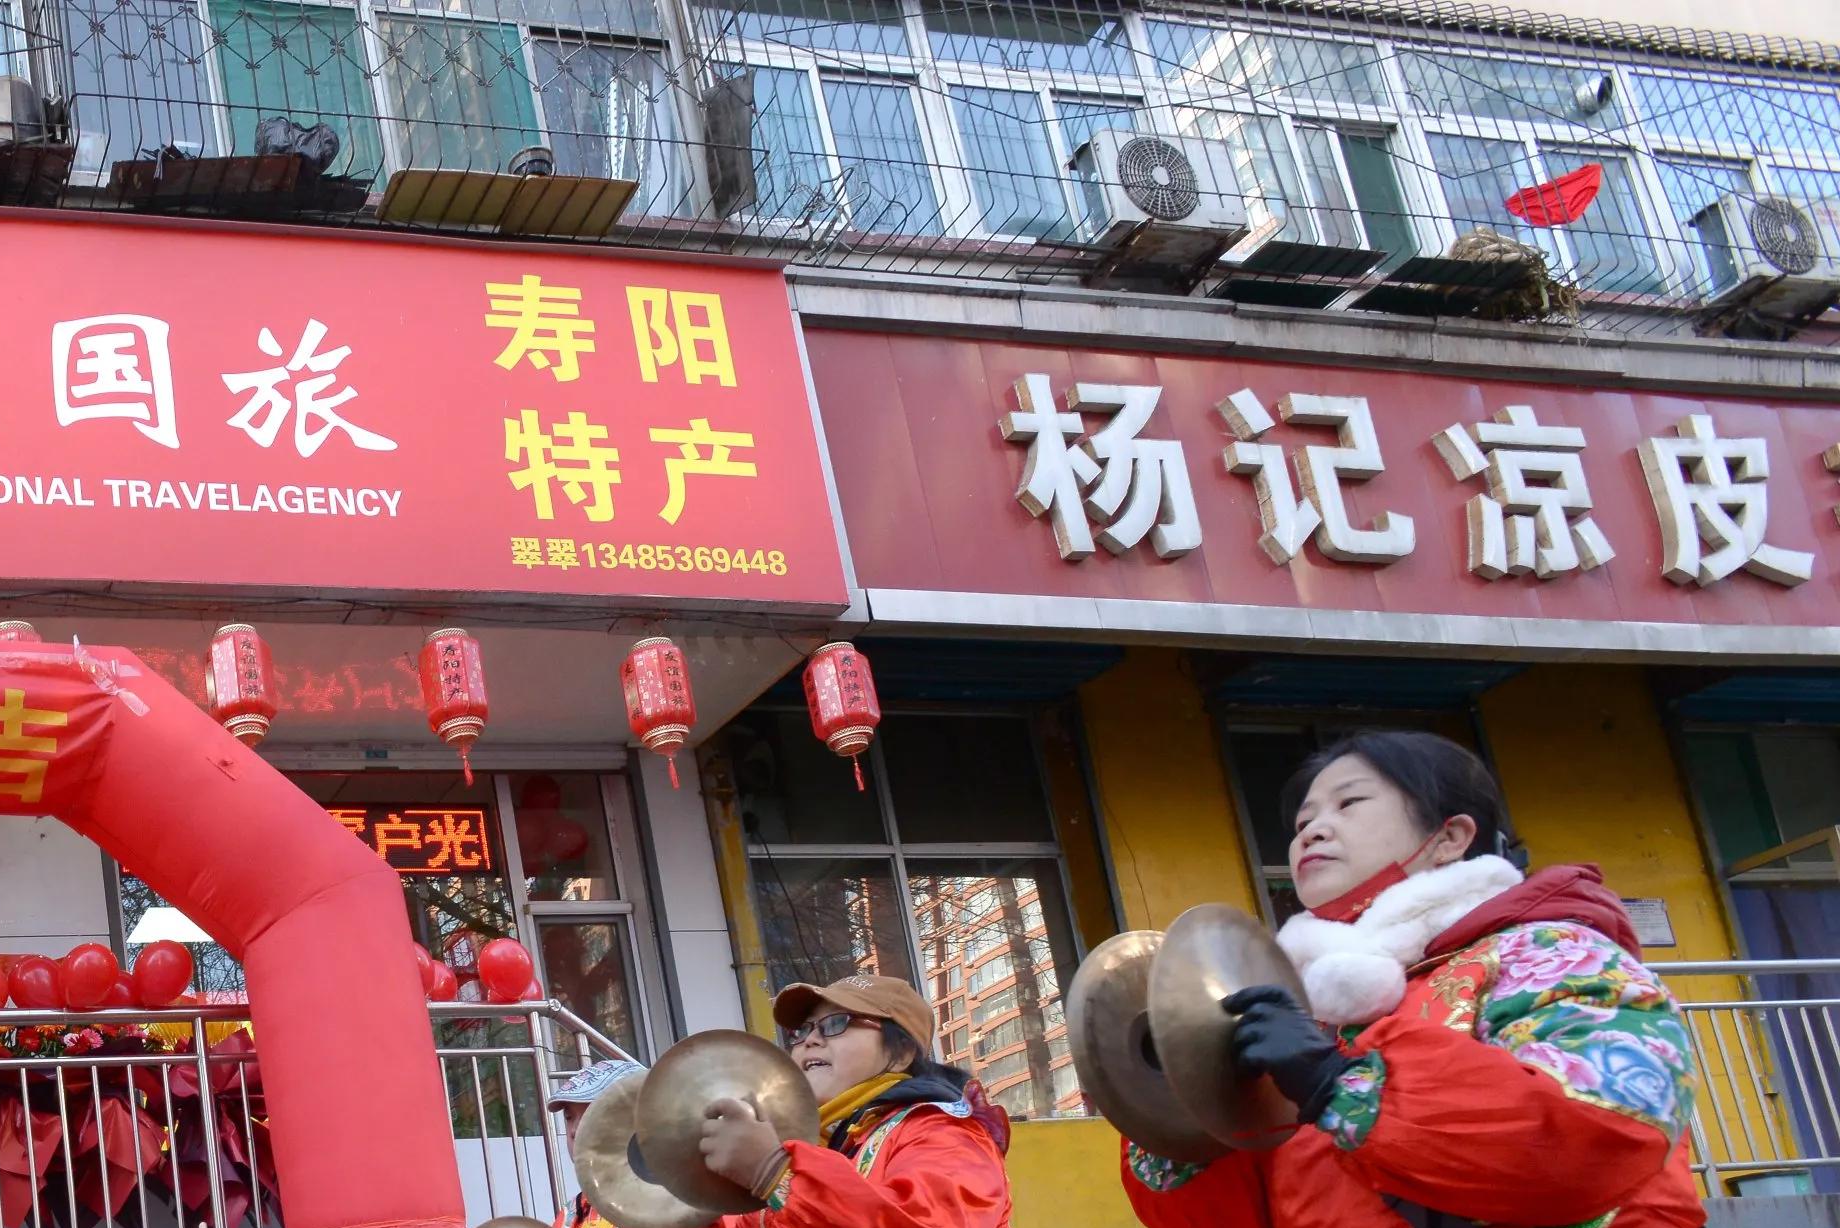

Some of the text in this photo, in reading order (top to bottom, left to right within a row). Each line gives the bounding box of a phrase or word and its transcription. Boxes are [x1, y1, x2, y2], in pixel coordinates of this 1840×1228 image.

[485, 274, 738, 388] 寿阳
[102, 479, 403, 518] TRAVELAGENCY
[504, 409, 758, 525] 特产
[999, 372, 1840, 588] 杨记凉皮
[511, 537, 788, 576] 翠翠13485369448
